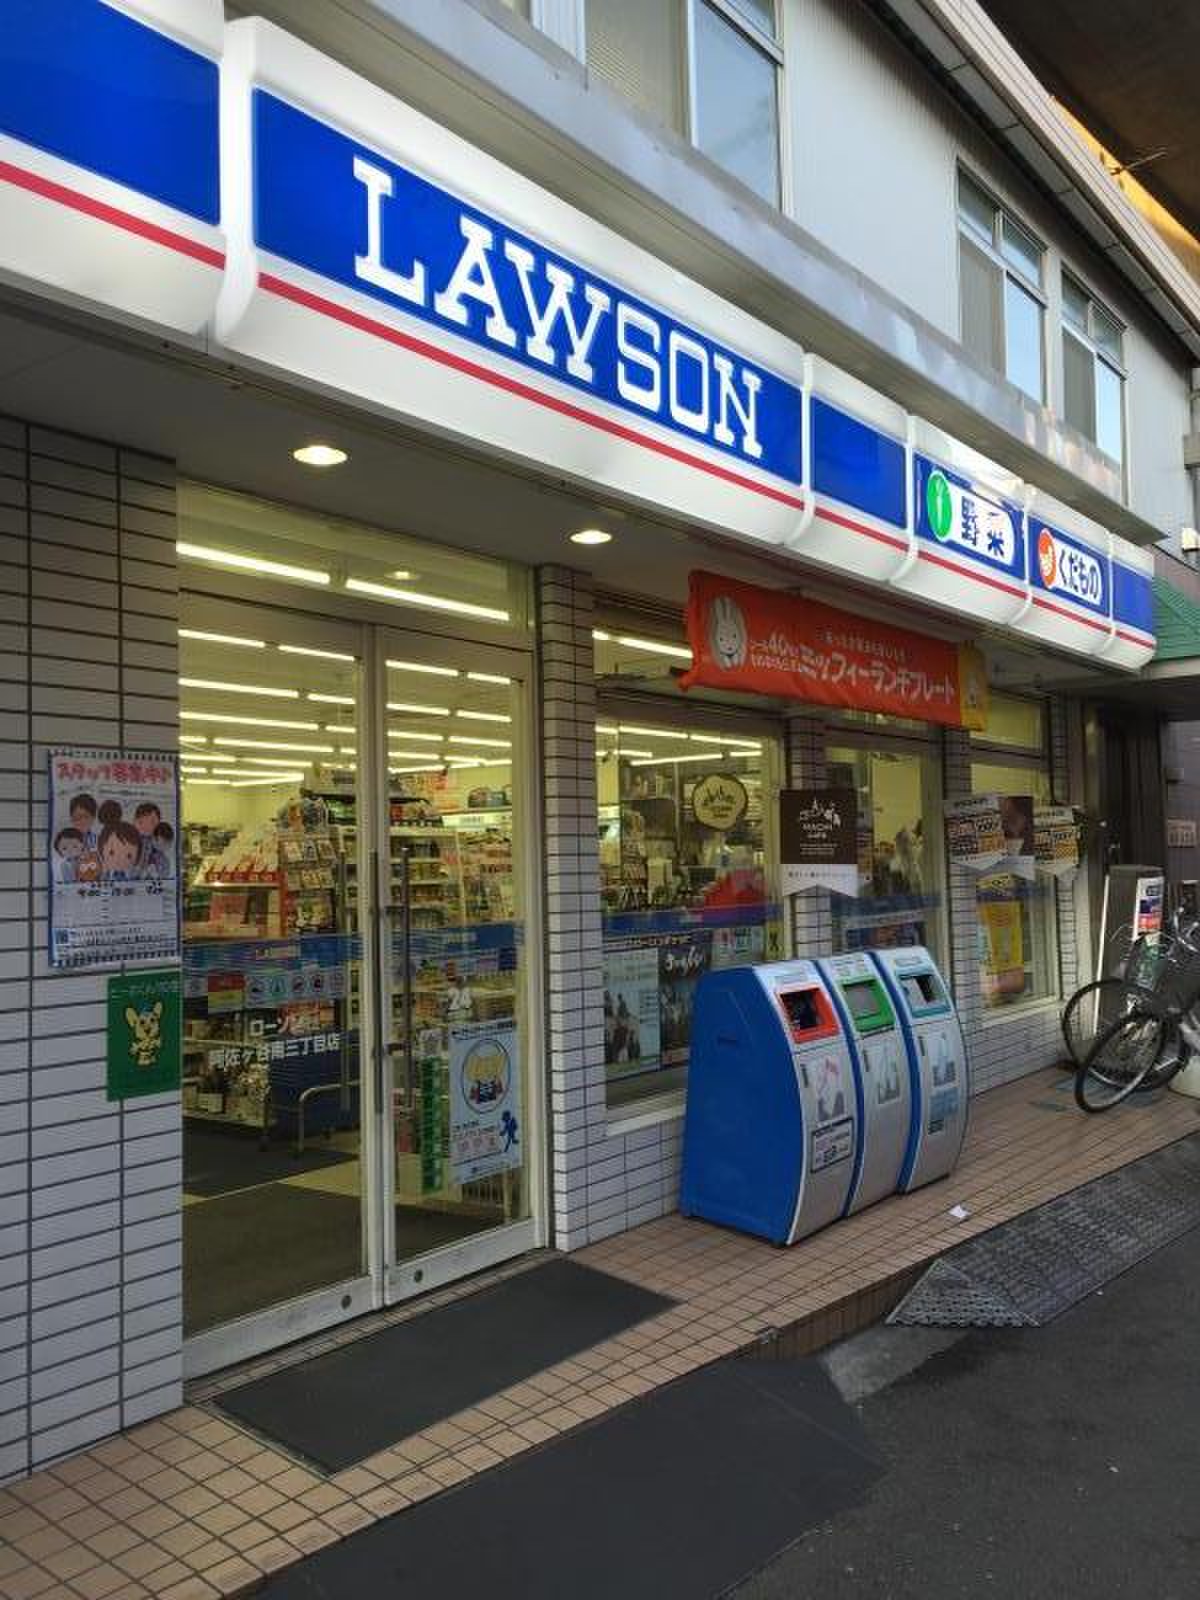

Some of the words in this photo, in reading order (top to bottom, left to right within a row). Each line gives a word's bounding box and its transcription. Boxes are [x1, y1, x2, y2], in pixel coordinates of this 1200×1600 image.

[353, 157, 763, 459] LAWSON
[1059, 549, 1100, 600] くだもの
